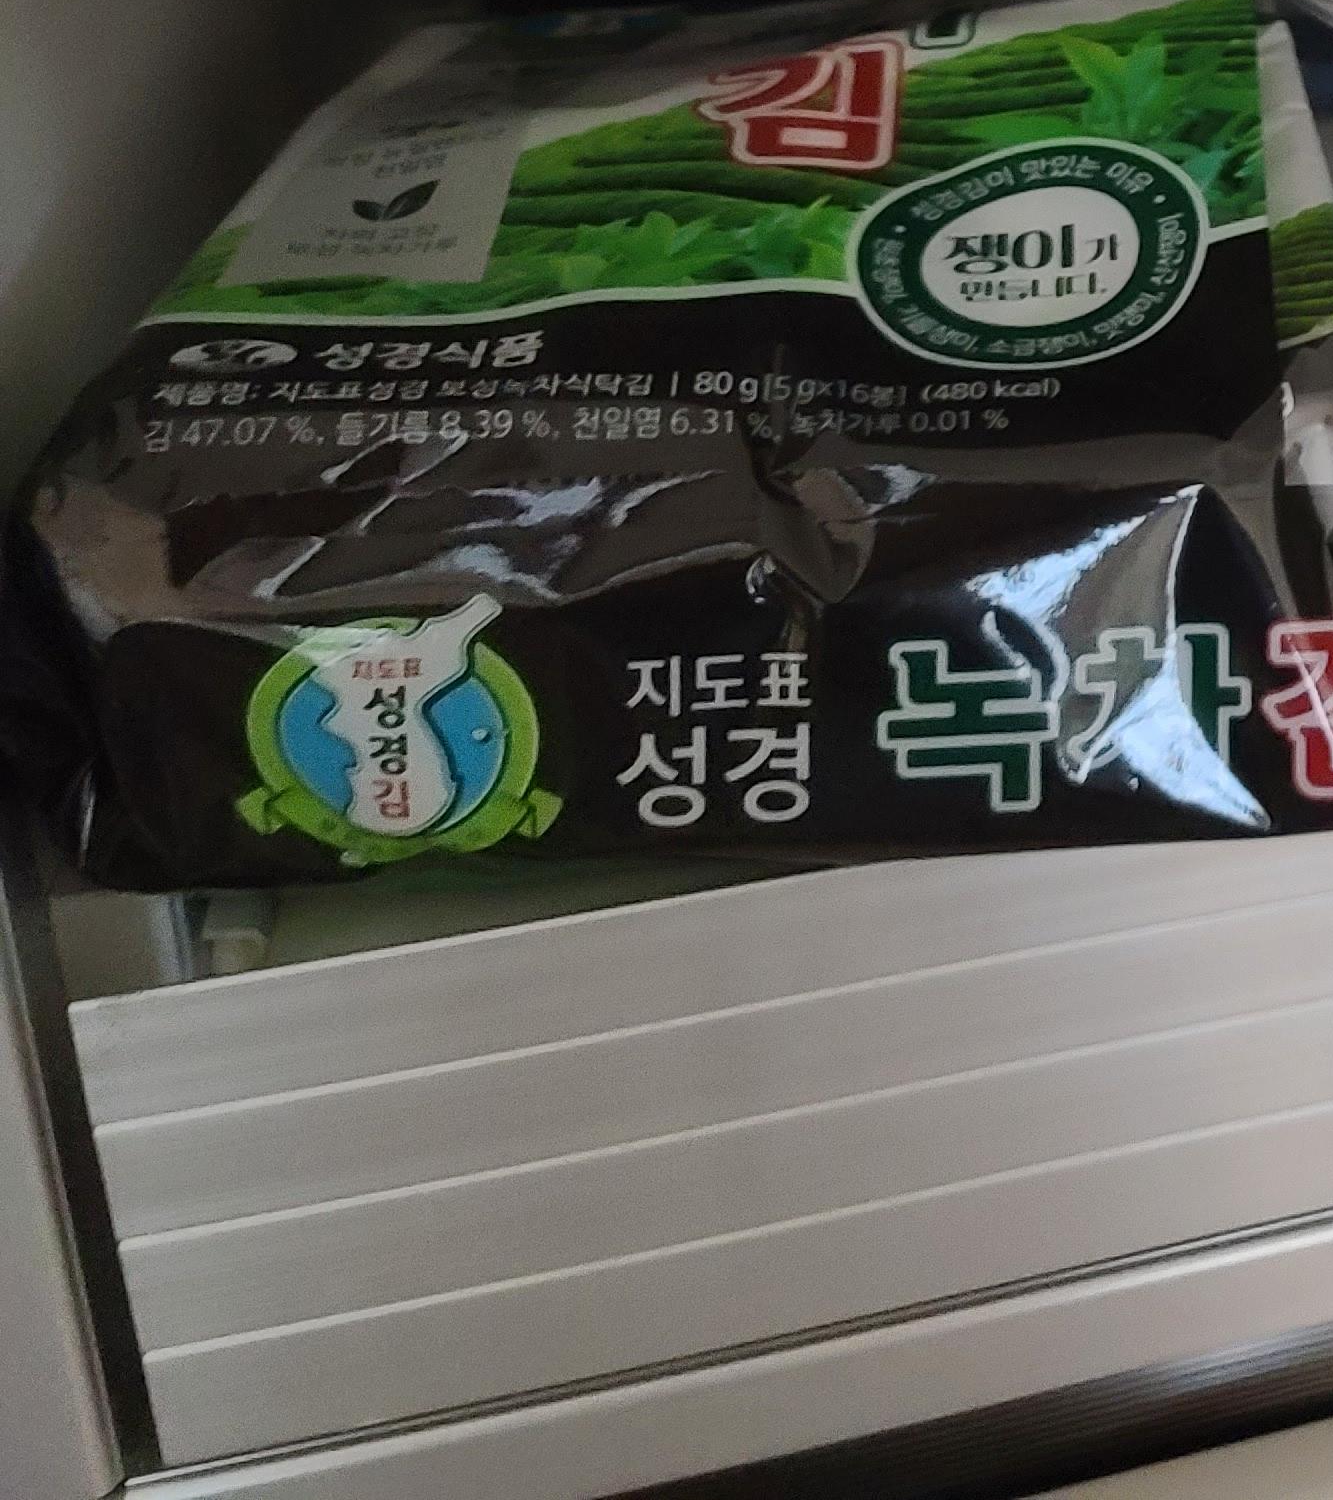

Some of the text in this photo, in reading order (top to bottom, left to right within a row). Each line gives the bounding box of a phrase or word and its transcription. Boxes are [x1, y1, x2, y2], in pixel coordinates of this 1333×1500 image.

[697, 38, 905, 171] 김
[1019, 154, 1101, 181] 맛있는
[1104, 160, 1155, 196] 이유
[314, 330, 545, 371] 성경식품
[921, 380, 987, 404] (480
[993, 377, 1062, 400] kcal)
[145, 418, 174, 454] 김
[180, 416, 279, 447] 47.07
[335, 410, 431, 447] 들기름
[439, 408, 514, 441] 8.39
[573, 406, 662, 441] 천일염
[669, 407, 736, 437] 6.31
[790, 408, 902, 438] 녹차가루
[910, 409, 971, 433] 0.01
[352, 657, 423, 680] 지도표
[626, 652, 813, 718] 지도표
[616, 722, 811, 828] 성경
